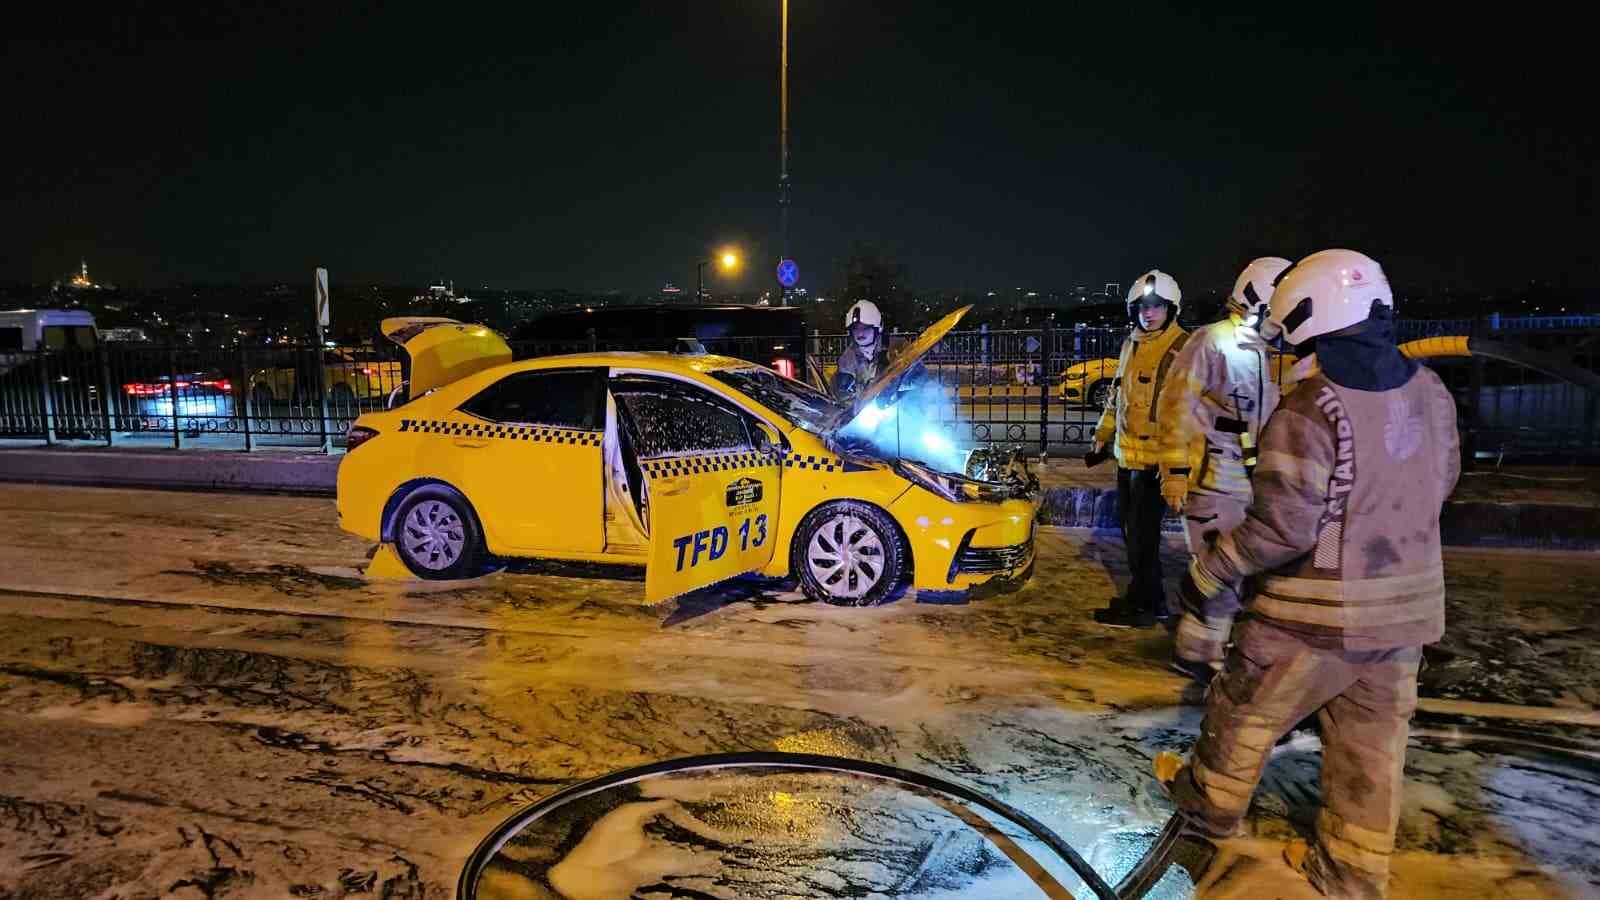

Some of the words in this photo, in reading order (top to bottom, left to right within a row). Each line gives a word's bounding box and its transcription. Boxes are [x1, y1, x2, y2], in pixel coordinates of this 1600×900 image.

[1315, 386, 1353, 523] STANBUL
[673, 526, 729, 572] TFD
[739, 513, 768, 551] 13
